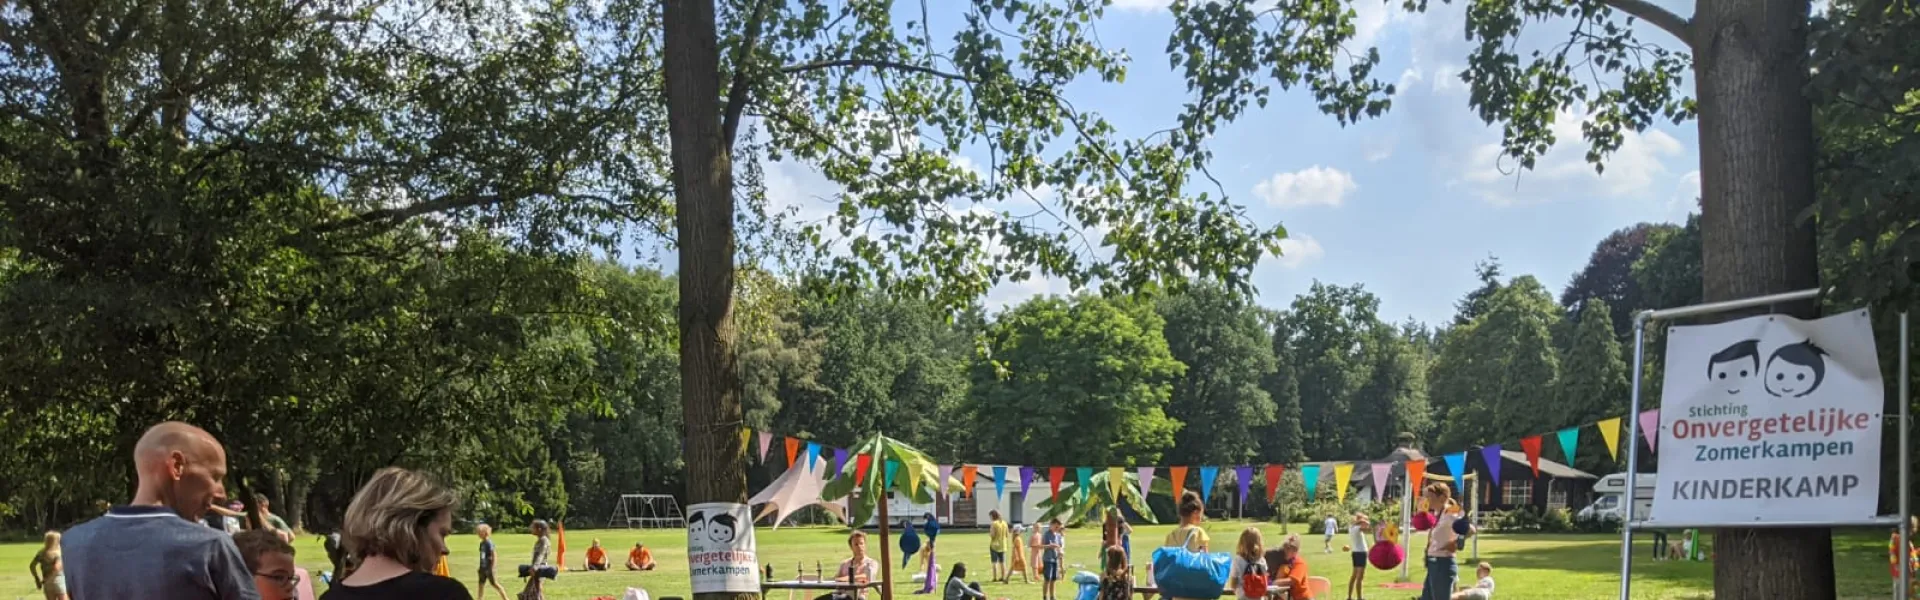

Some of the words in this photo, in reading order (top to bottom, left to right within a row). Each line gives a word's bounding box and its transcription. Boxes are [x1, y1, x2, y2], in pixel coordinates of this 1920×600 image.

[1689, 402, 1748, 417] Stichting
[1672, 408, 1869, 441] Onvergetelijke
[1695, 440, 1853, 462] Zomerkampen
[1672, 474, 1859, 500] KINDERKAMP
